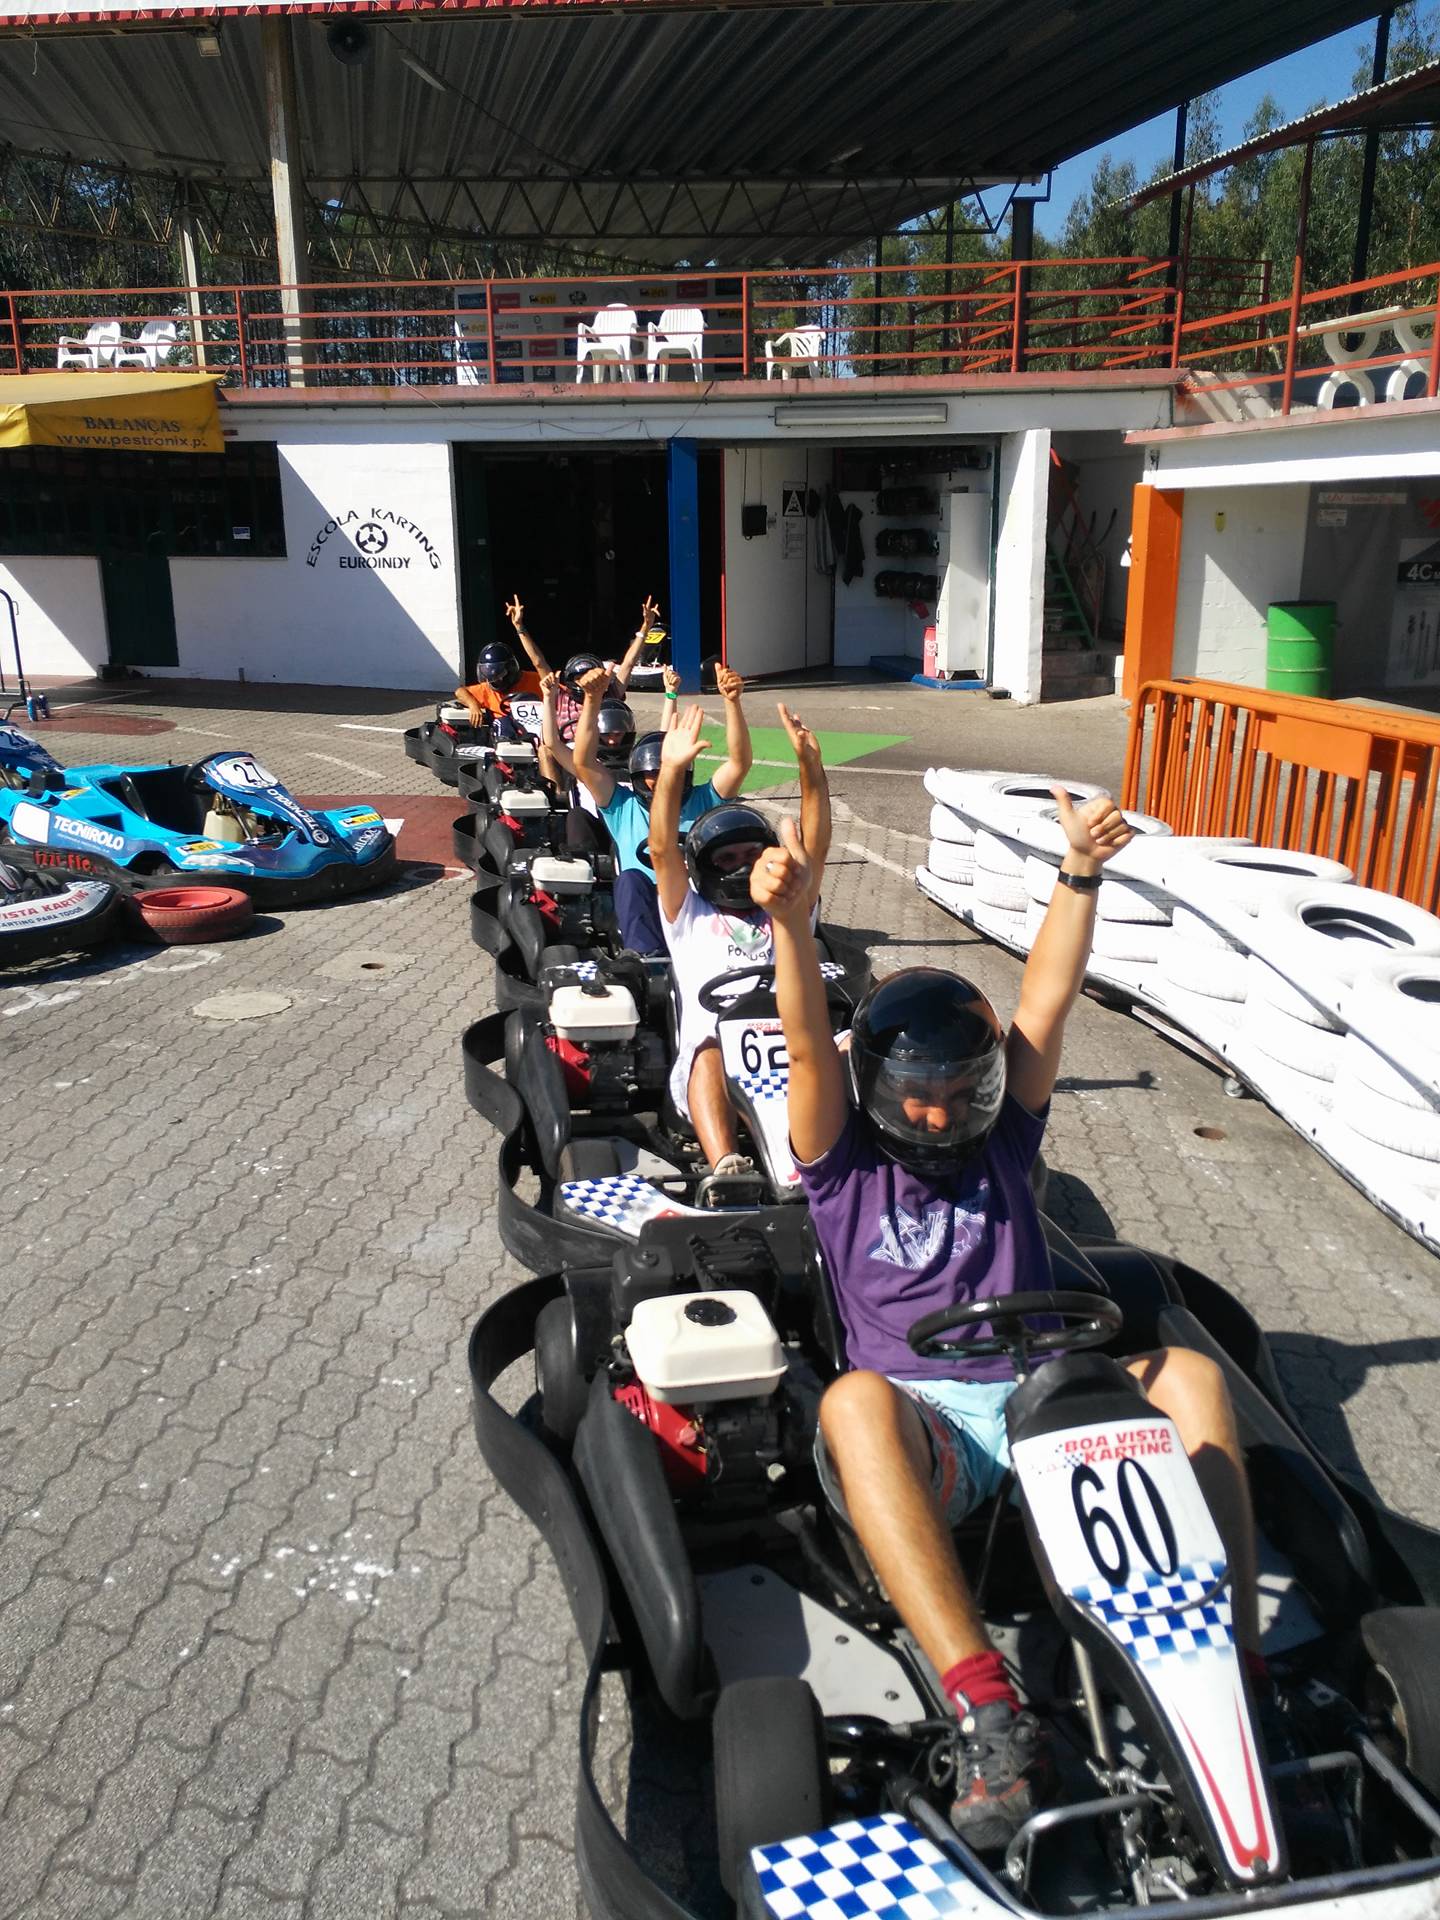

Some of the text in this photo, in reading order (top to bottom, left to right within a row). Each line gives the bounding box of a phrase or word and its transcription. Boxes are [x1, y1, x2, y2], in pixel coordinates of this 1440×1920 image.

[83, 416, 180, 435] BALANÇAS
[306, 507, 442, 570] ESCOLA KARTING
[339, 556, 411, 569] EUROINDY
[516, 704, 539, 720] 64
[233, 761, 275, 787] 27
[54, 816, 124, 850] TECNIROLO
[41, 890, 90, 912] KARTING
[0, 918, 35, 929] ARTING
[1064, 1428, 1171, 1453] BOA VISTA
[1083, 1441, 1174, 1466] KARTING
[1070, 1457, 1180, 1588] 60
